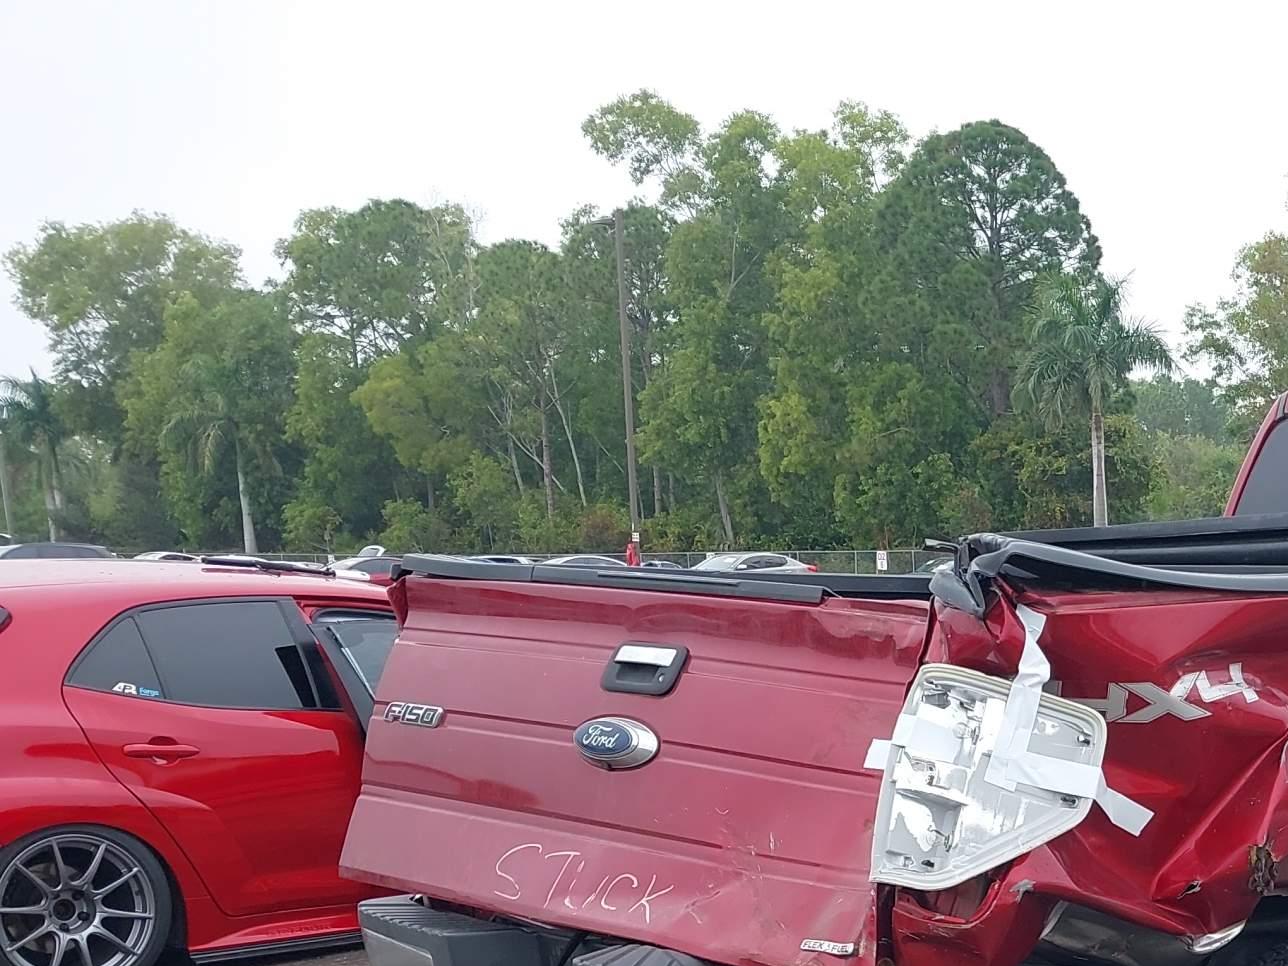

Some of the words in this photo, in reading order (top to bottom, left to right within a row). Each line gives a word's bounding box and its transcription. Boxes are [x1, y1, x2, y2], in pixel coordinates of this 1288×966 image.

[384, 702, 445, 728] F-150
[582, 724, 620, 748] Ford
[802, 940, 825, 950] FLEX
